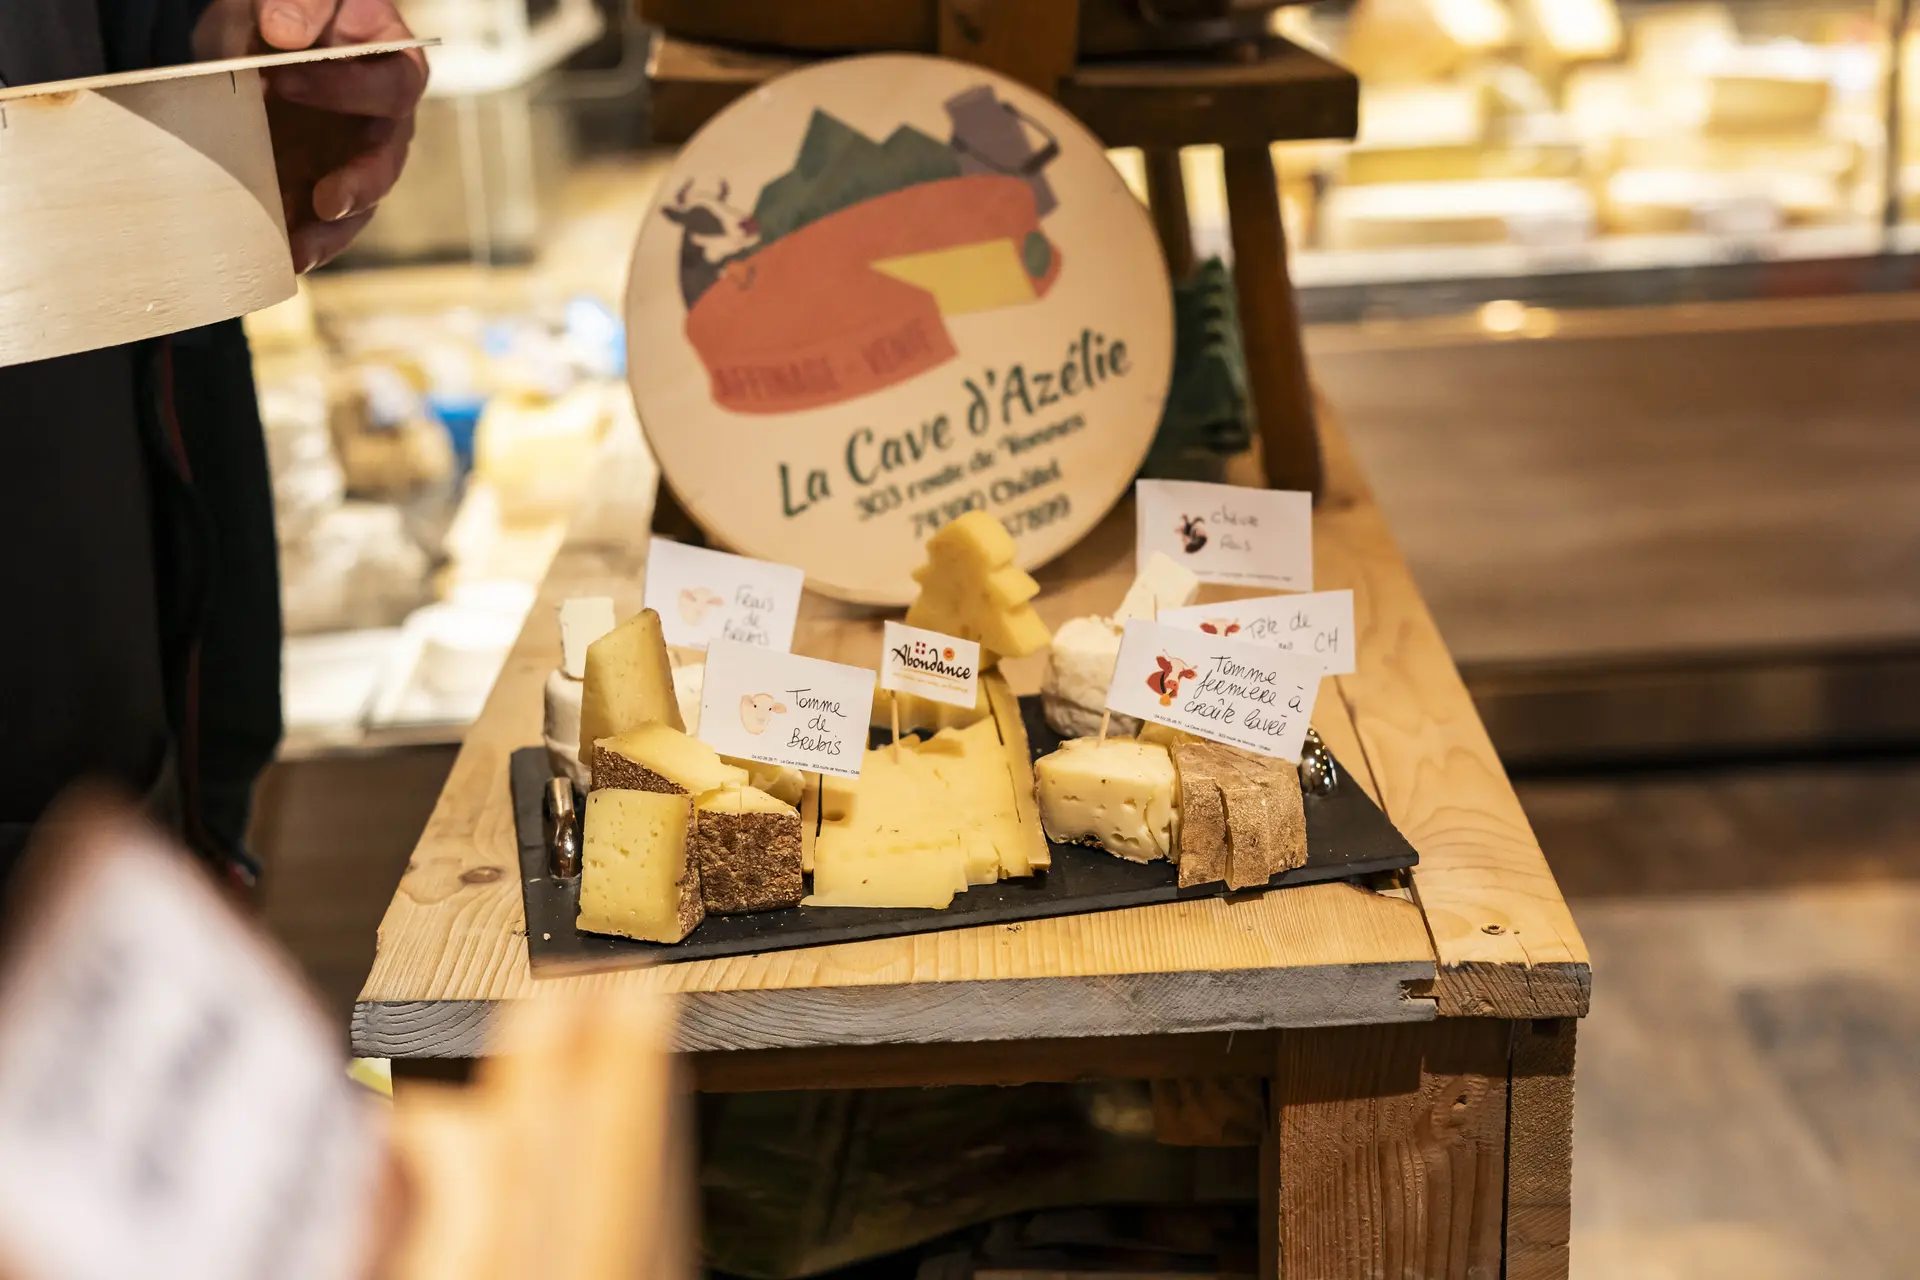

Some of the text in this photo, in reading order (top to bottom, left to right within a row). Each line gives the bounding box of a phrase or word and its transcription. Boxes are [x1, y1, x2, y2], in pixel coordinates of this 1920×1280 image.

[778, 329, 1132, 518] La Cave d'Azélie
[1289, 610, 1312, 631] de
[1314, 626, 1338, 653] CH
[891, 643, 971, 680] Abondance
[1210, 655, 1277, 685] Tomme
[785, 688, 848, 718] Tomme
[808, 714, 830, 732] de
[786, 727, 841, 756] Brebis
